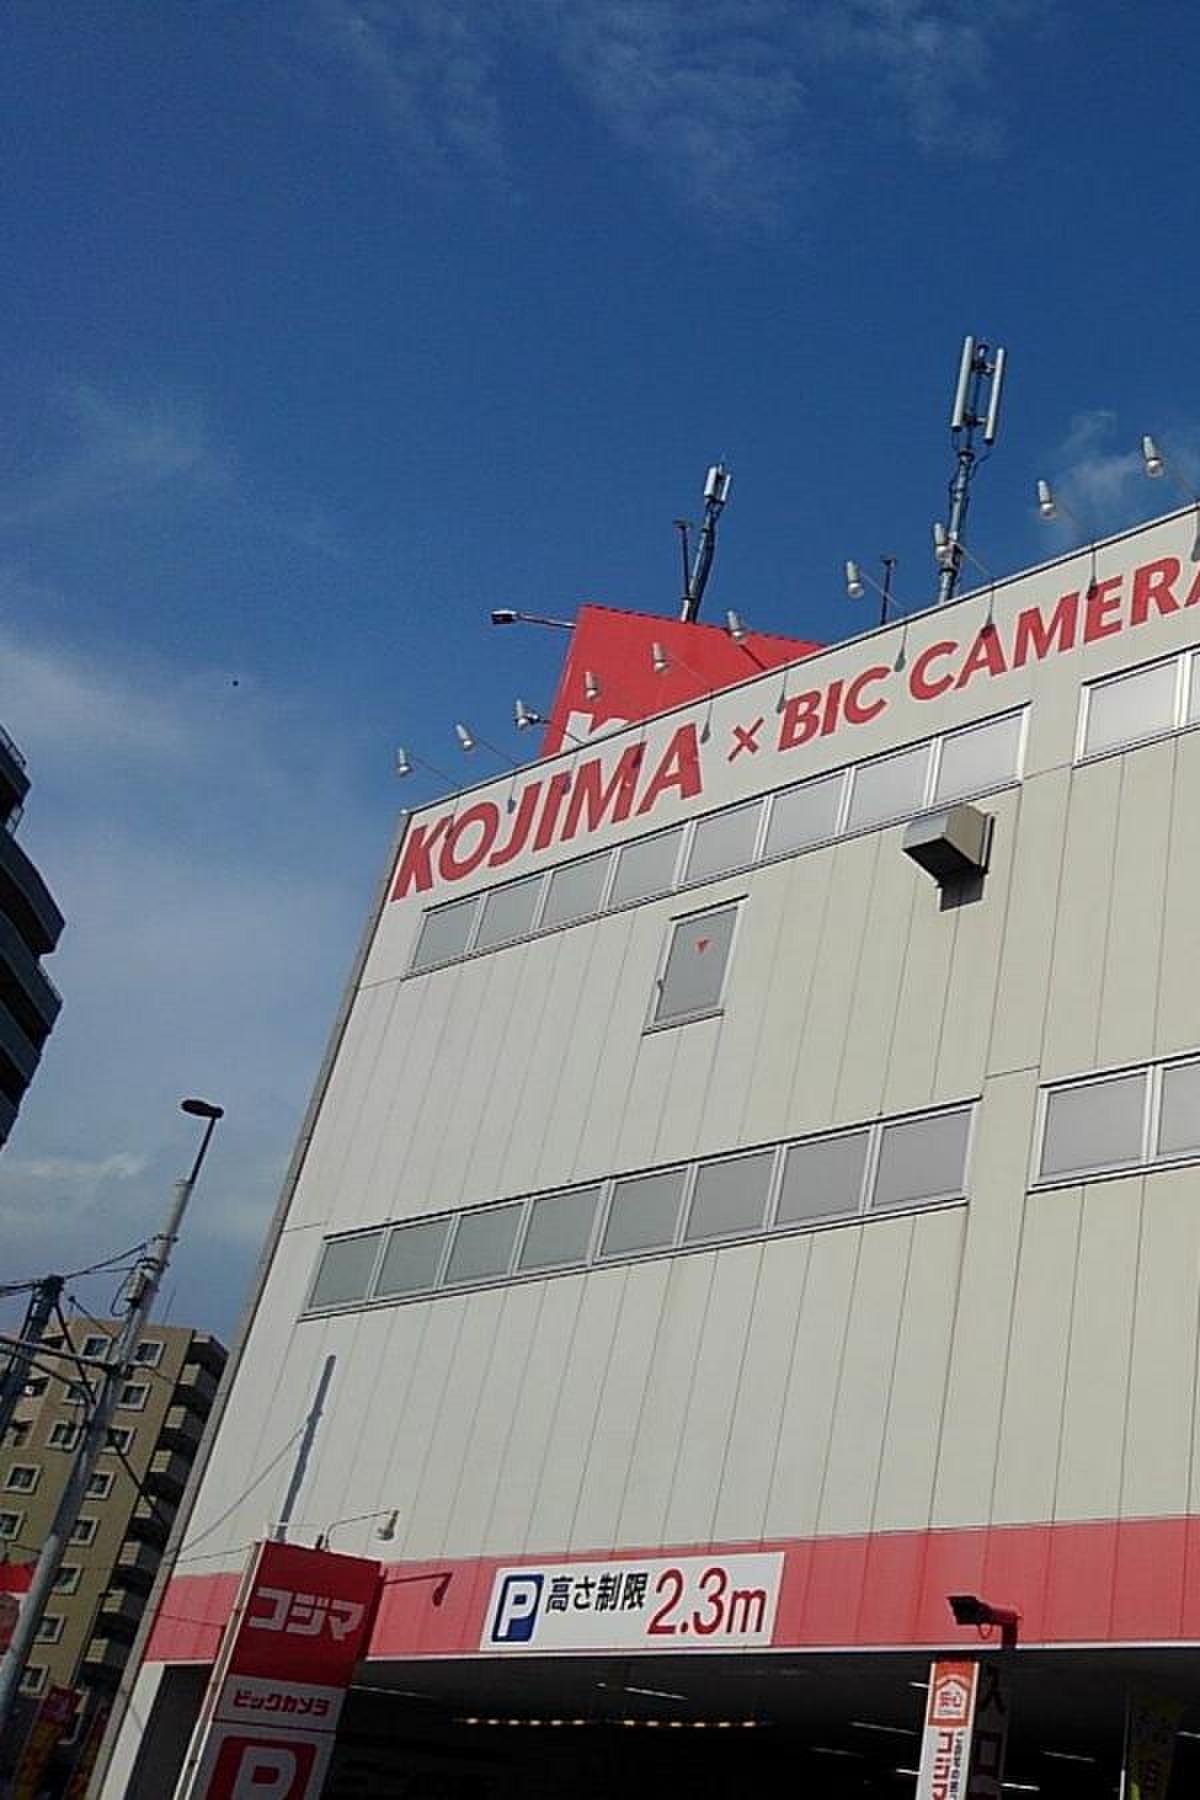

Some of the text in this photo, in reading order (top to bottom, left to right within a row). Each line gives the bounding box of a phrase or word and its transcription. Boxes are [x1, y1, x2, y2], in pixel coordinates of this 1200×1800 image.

[391, 720, 706, 903] KOJIMA
[777, 665, 891, 752] BIC
[249, 1586, 365, 1641] コジマ
[496, 1578, 539, 1639] P
[545, 1567, 768, 1636] 高さ制限 2.3m
[233, 1689, 331, 1717] ビックカメラ
[228, 1743, 298, 1800] P
